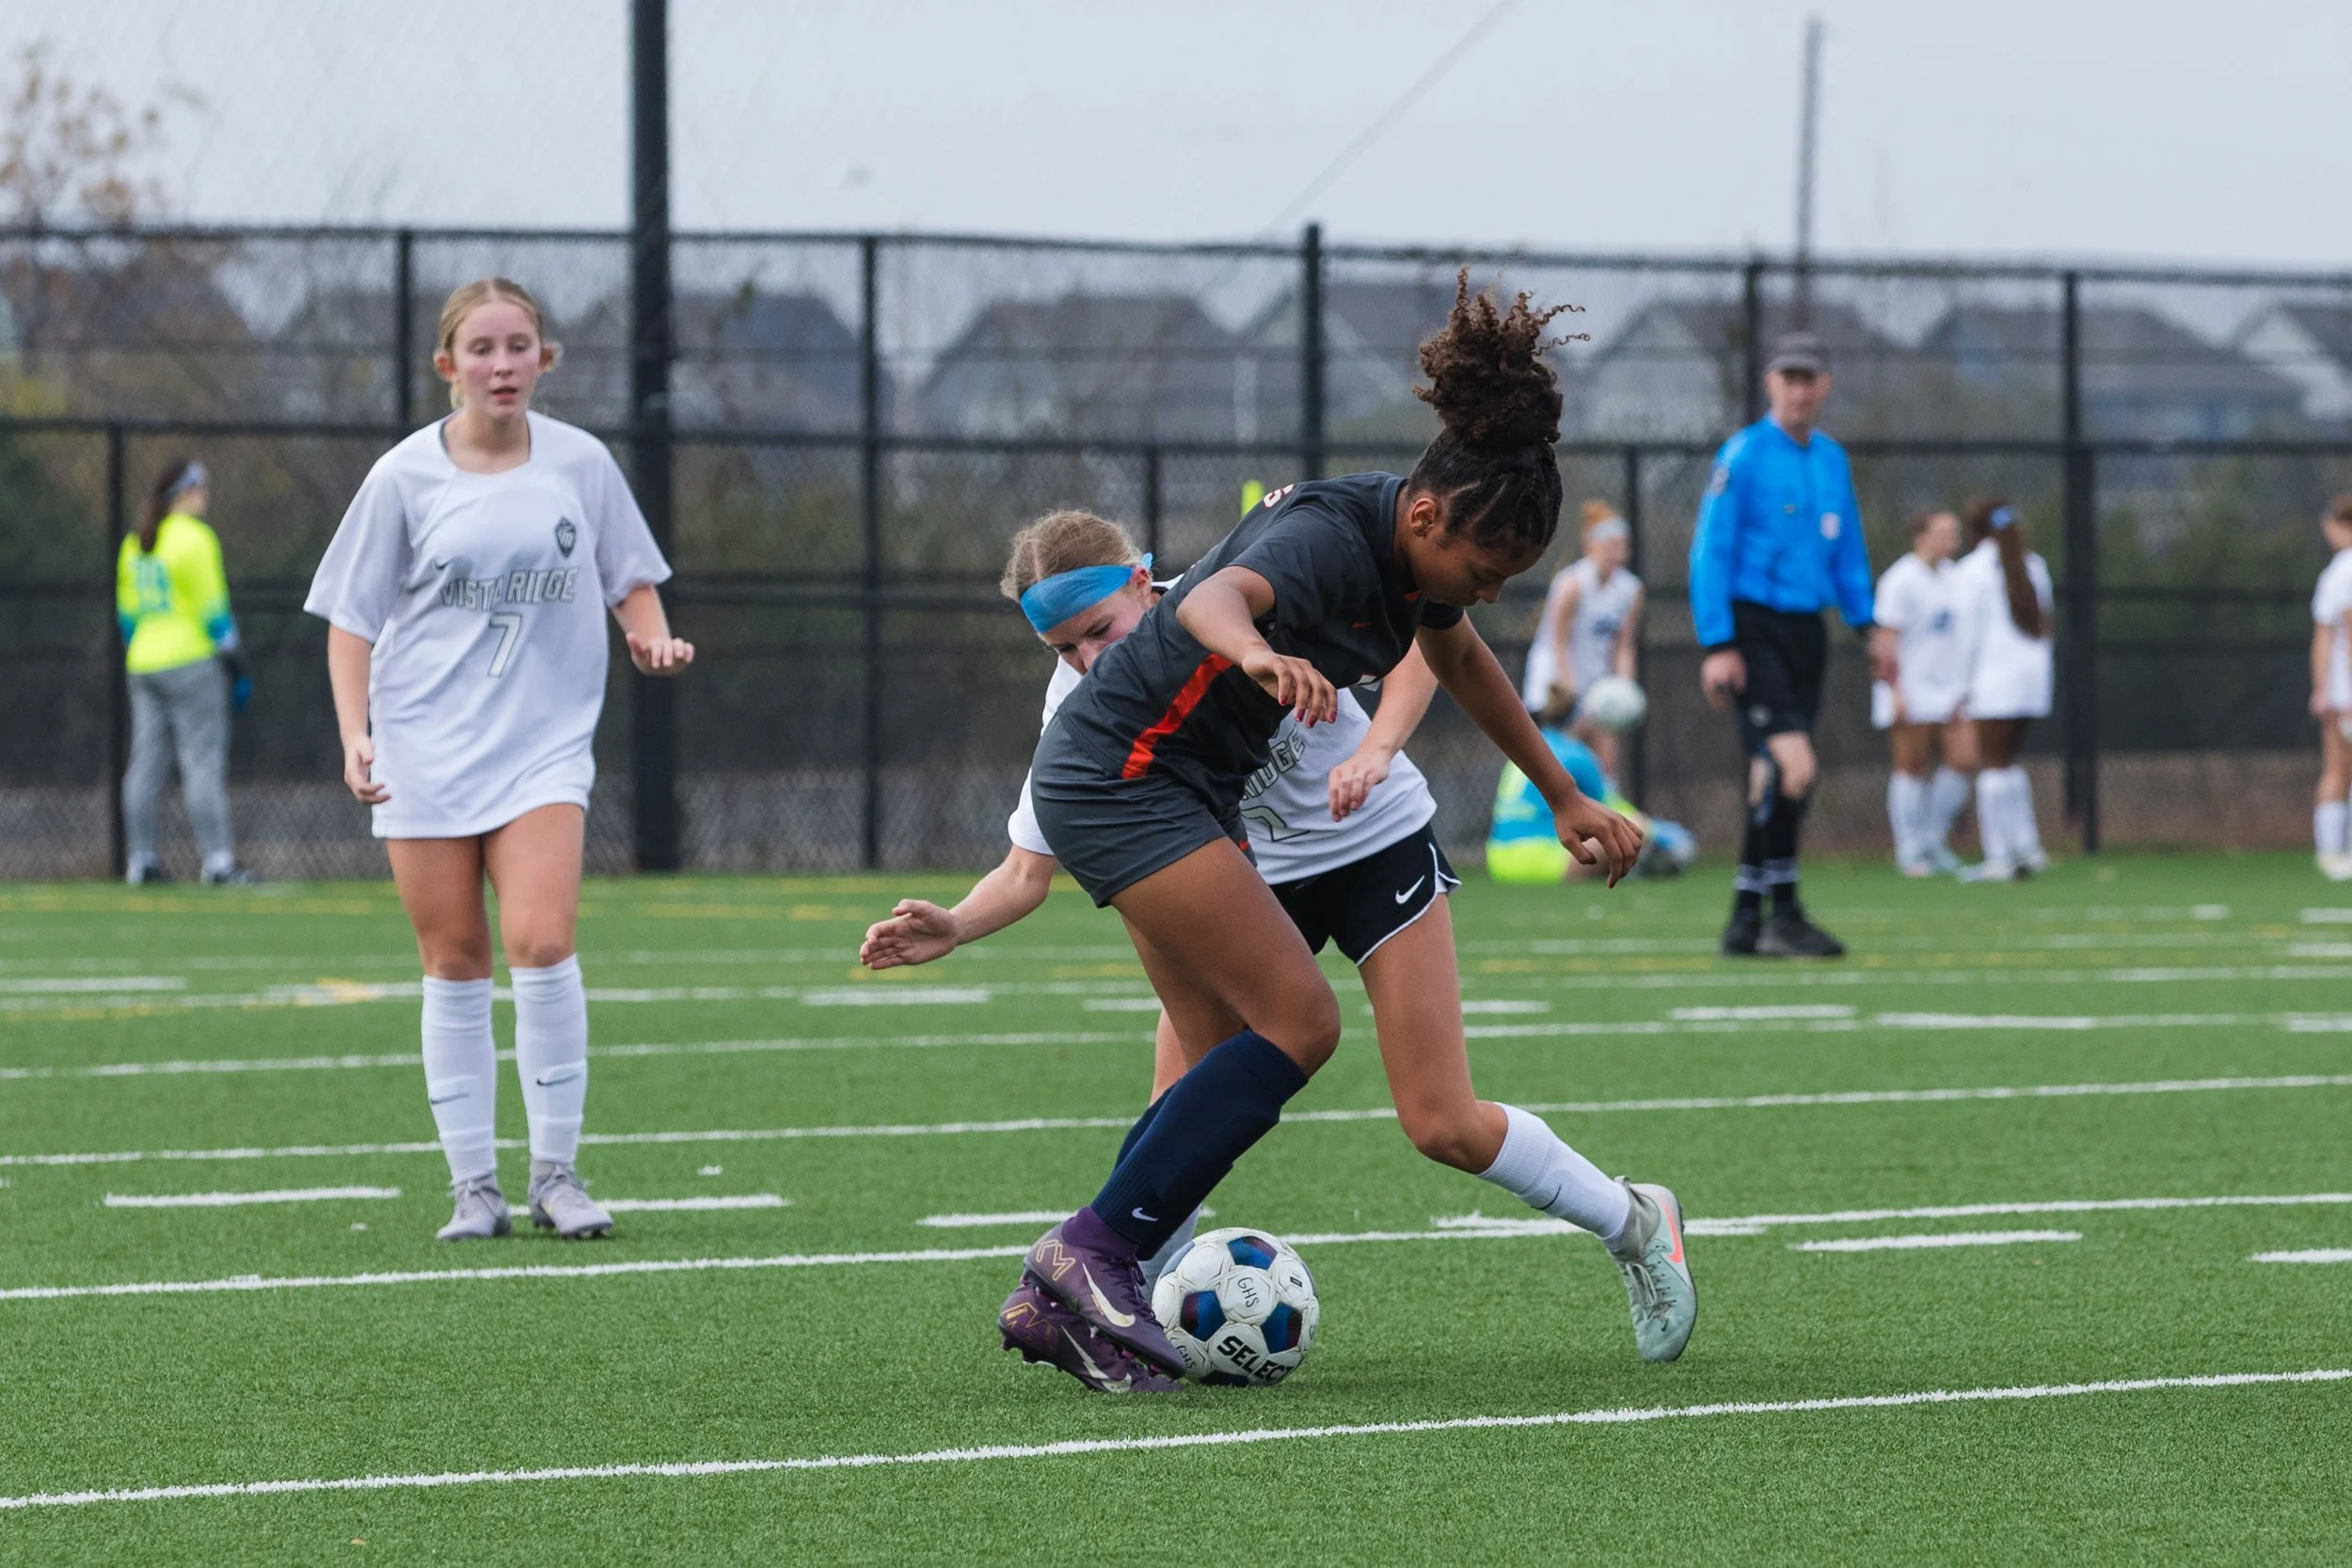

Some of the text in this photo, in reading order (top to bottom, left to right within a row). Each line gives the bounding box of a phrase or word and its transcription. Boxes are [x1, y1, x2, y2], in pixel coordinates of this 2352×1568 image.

[439, 574, 505, 611] VISTA
[486, 611, 522, 679] 7
[1237, 1276, 1260, 1307] GHS
